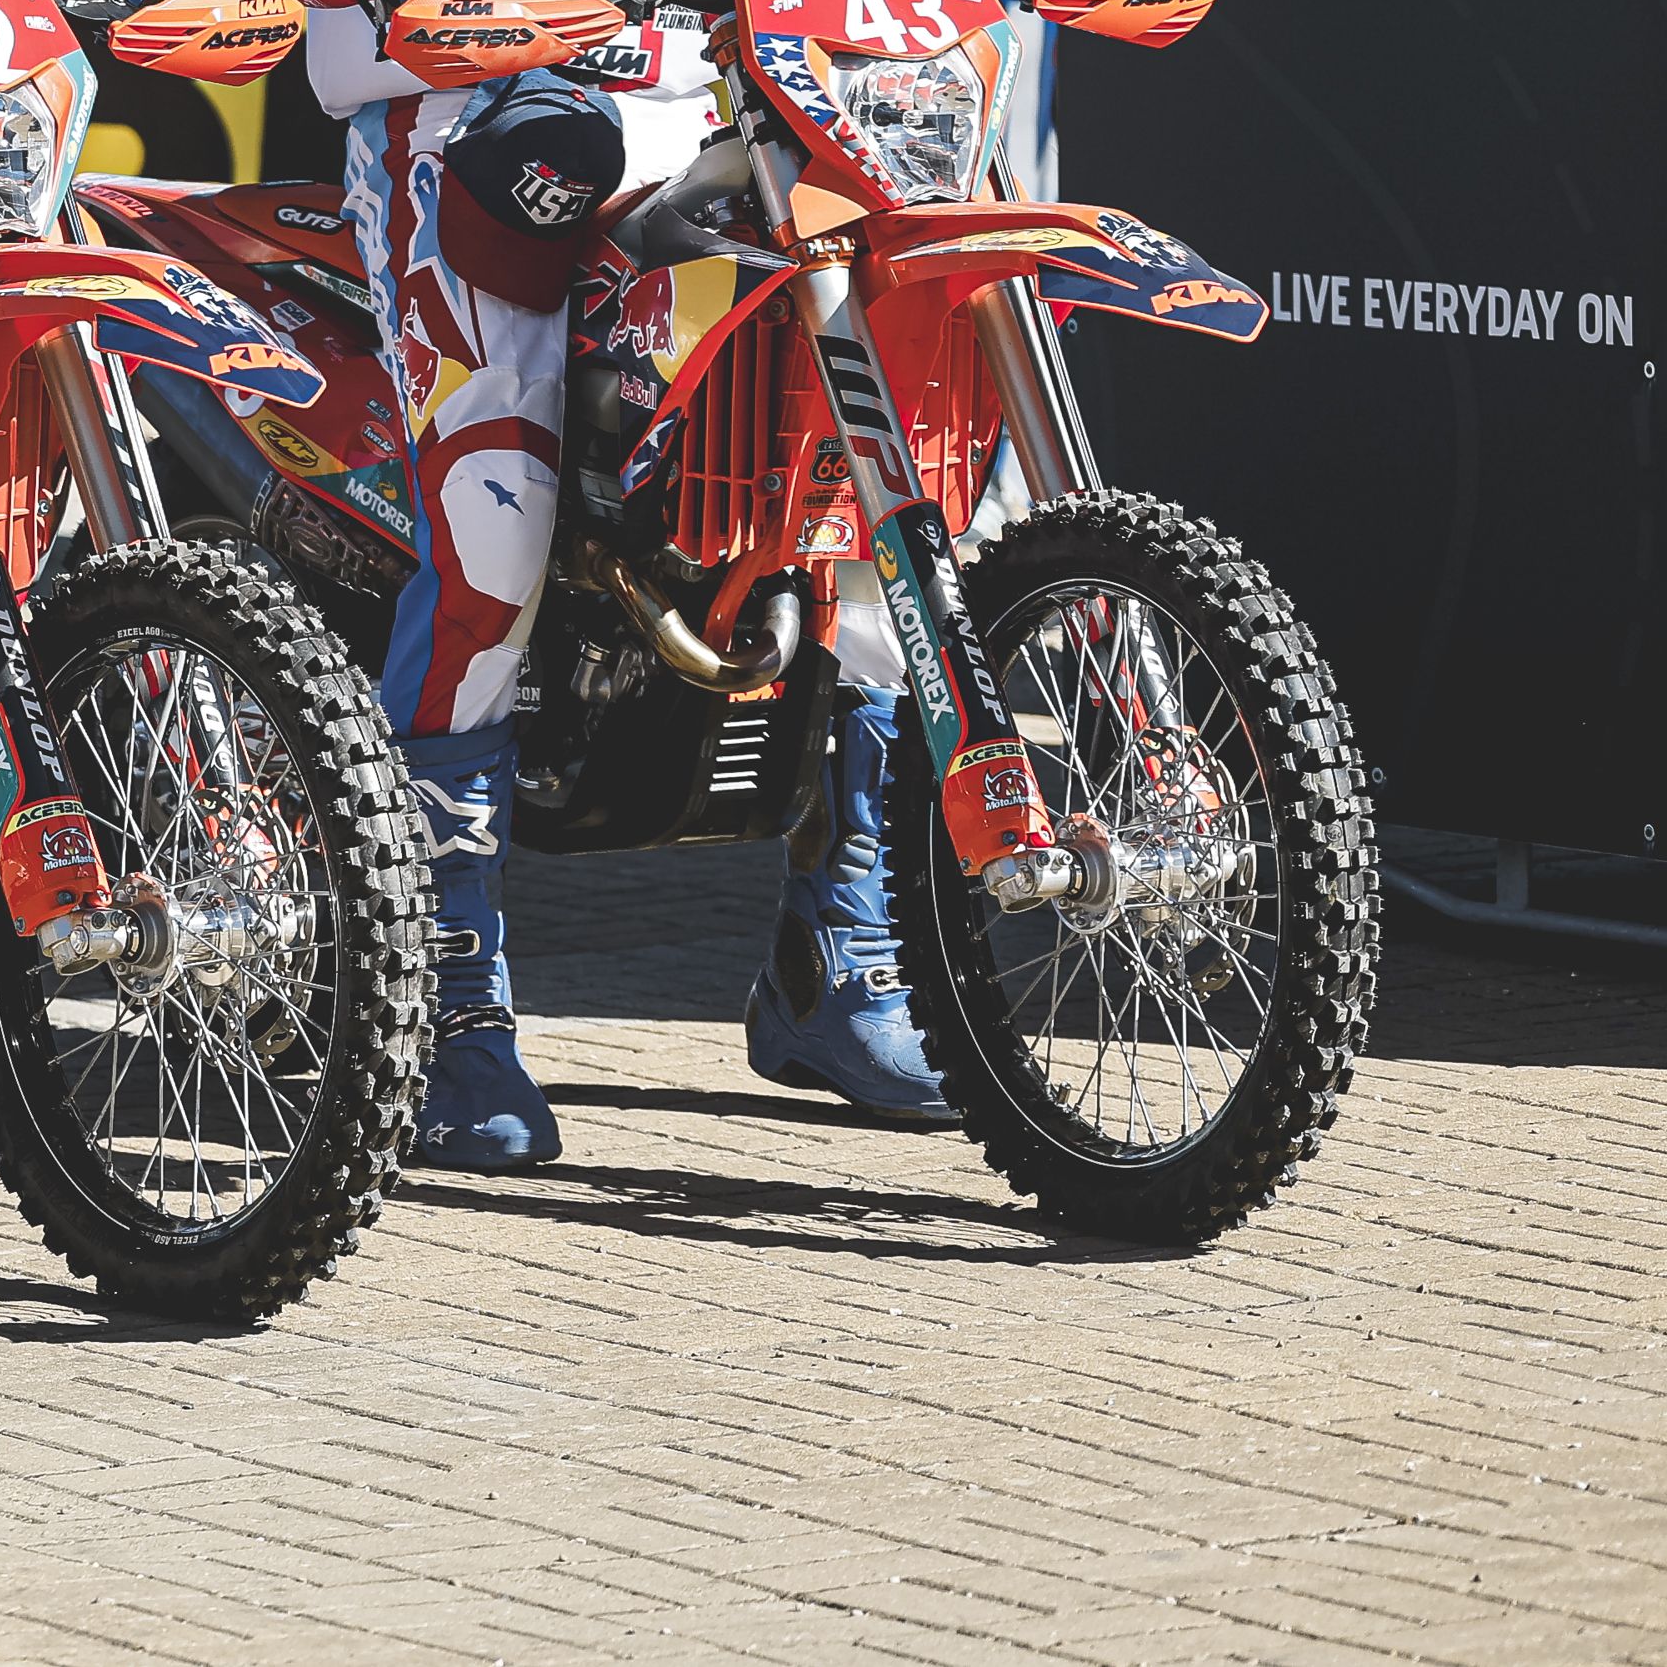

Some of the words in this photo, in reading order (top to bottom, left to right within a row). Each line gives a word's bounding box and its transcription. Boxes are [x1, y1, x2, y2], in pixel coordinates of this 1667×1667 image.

[200, 21, 299, 51] ACERBIS
[403, 26, 535, 49] ACERBIS
[572, 45, 649, 76] KTM
[74, 67, 96, 144] MOTOREX
[278, 208, 343, 230] GUTS
[1149, 280, 1260, 318] KTM
[1272, 272, 1351, 326] LIVE
[1364, 278, 1563, 341] EVERYDAY
[1578, 292, 1633, 346] ON
[209, 343, 308, 376] KTM
[363, 426, 381, 443] Twin
[377, 437, 394, 452] Air
[818, 457, 848, 479] 66
[345, 476, 414, 539] MOTOREX
[117, 626, 144, 639] EXCEL
[932, 552, 1005, 726] DUNLOP
[888, 577, 954, 725] MOTOREX
